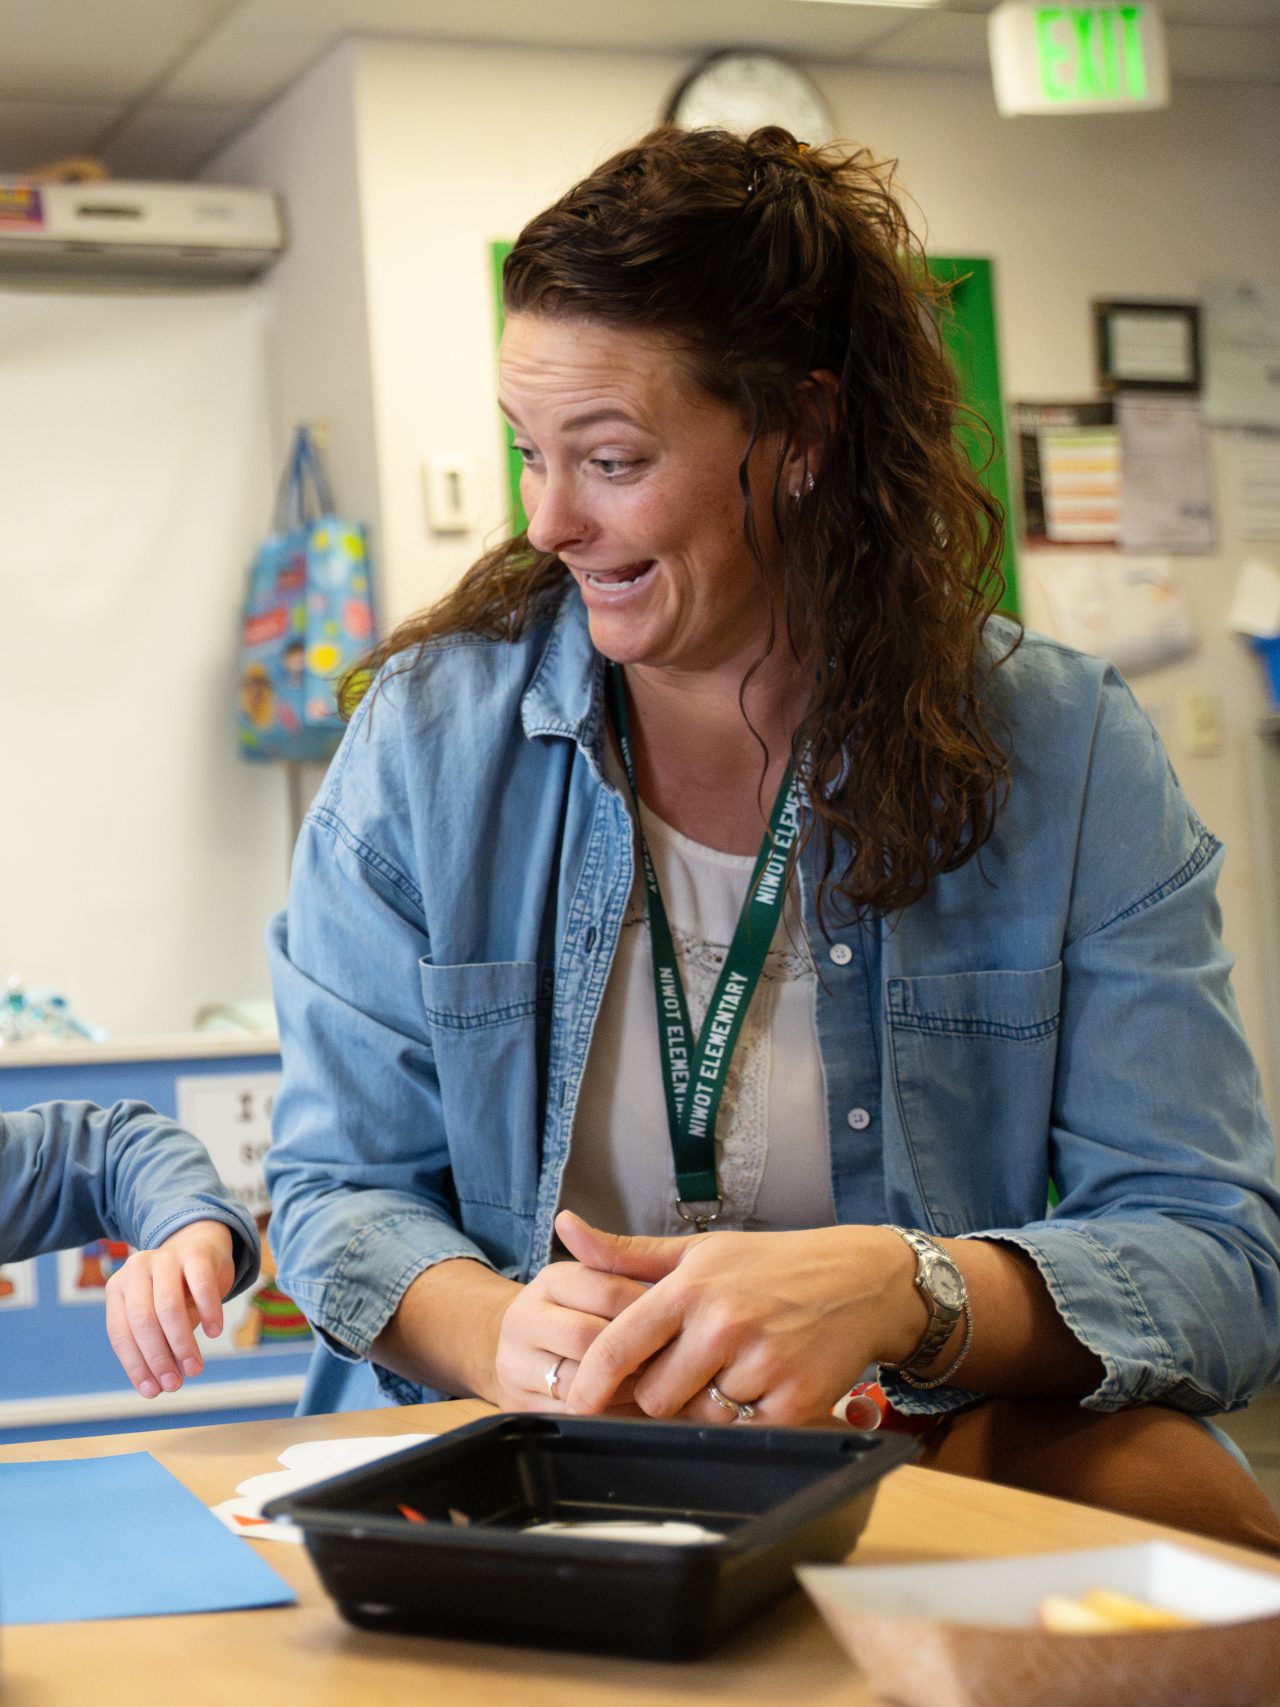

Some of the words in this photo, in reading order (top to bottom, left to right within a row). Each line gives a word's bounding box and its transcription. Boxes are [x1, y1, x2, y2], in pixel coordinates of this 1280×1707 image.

[1036, 6, 1147, 101] EXIT
[755, 850, 787, 906] NIWOT
[659, 967, 682, 1020] NIWOT
[700, 971, 748, 1080] ELEMENTARY
[688, 1082, 714, 1138] NIWOT
